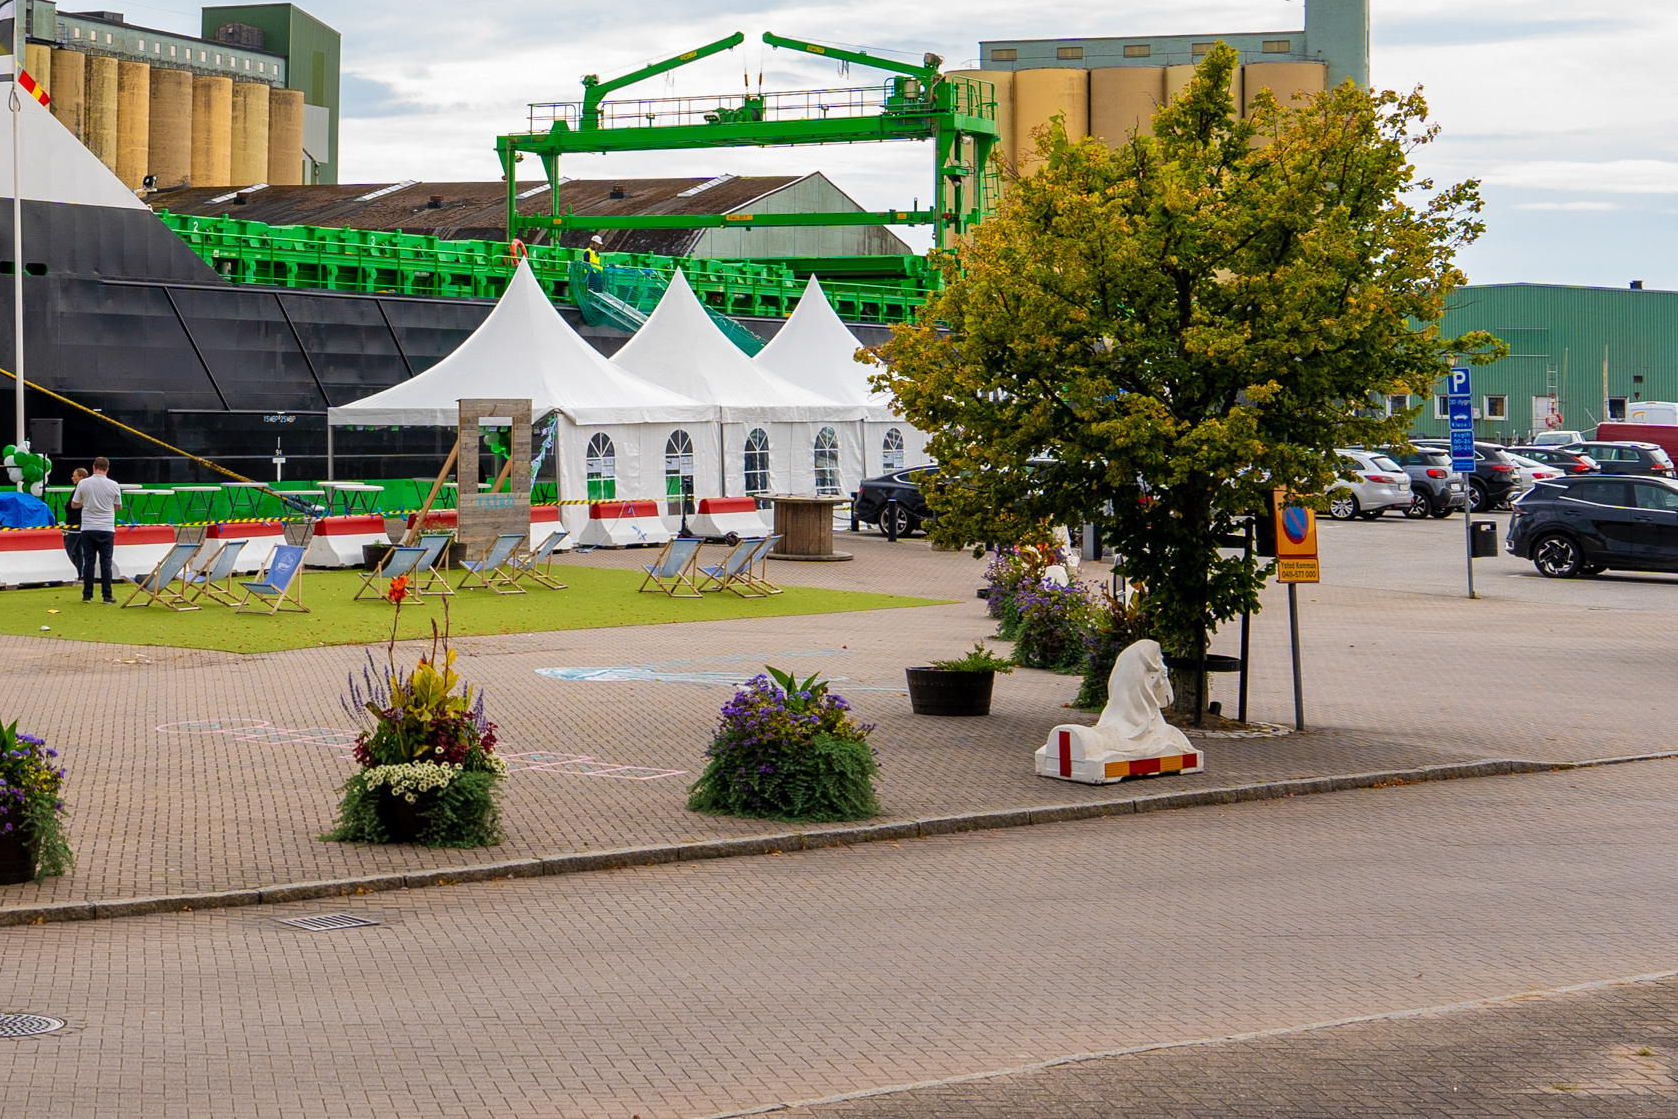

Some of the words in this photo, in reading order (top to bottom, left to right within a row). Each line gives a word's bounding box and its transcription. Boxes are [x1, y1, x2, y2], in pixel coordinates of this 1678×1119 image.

[193, 221, 199, 232] 2
[370, 235, 376, 246] 3
[1453, 371, 1466, 392] P
[476, 496, 515, 510] YSTAD
